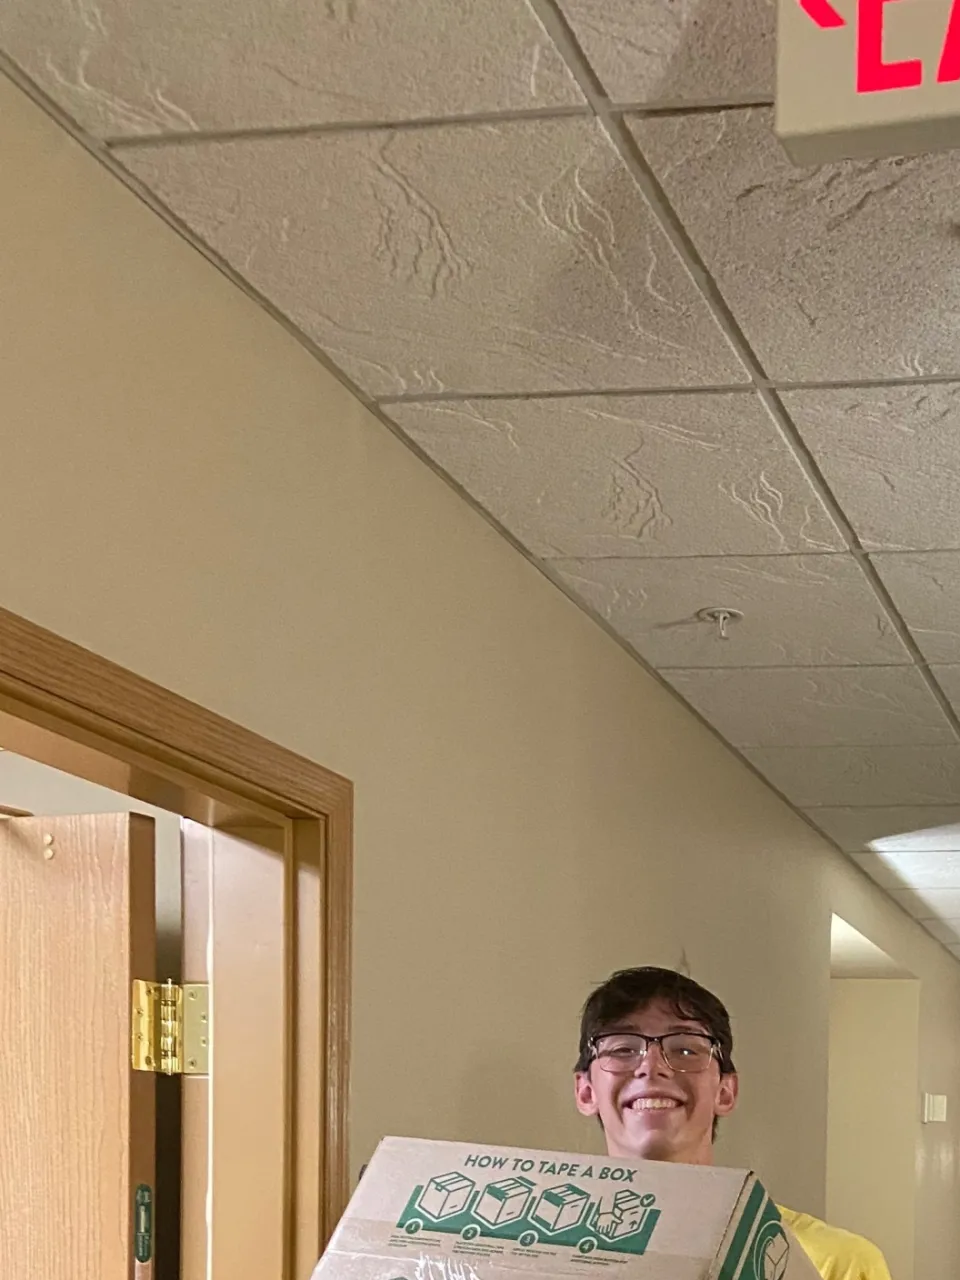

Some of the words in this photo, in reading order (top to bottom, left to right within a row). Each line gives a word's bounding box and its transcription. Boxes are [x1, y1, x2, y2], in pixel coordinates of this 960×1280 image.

[464, 1154, 508, 1169] HOW
[512, 1158, 535, 1172] TO
[538, 1161, 579, 1177] TAPE
[580, 1165, 594, 1178] A
[598, 1166, 638, 1183] BOX
